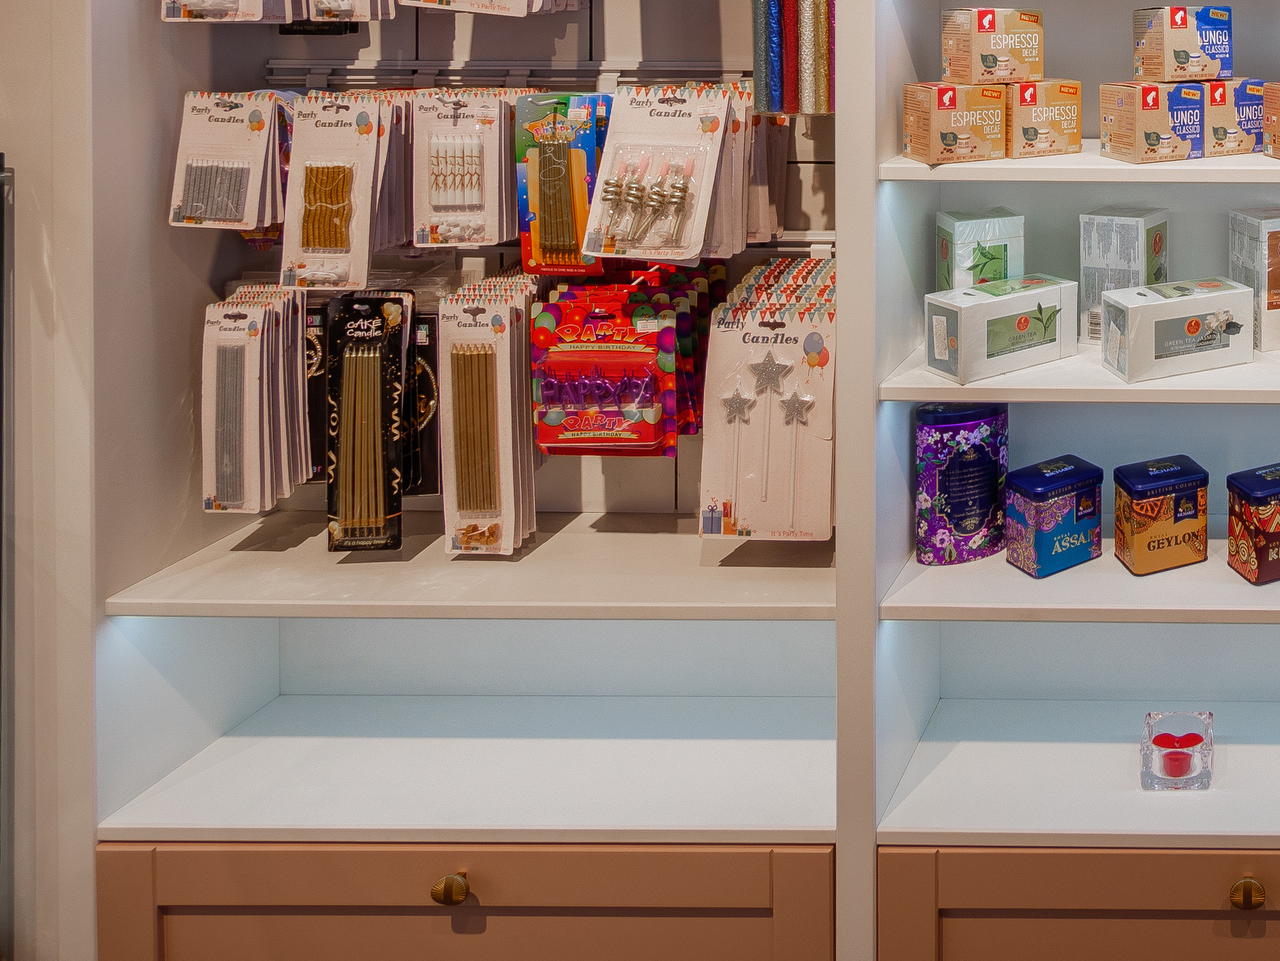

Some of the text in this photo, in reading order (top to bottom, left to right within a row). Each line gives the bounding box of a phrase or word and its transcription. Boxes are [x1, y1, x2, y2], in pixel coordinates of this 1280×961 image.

[1021, 14, 1038, 23] NEW!
[990, 34, 1039, 49] ESPRESSO
[1197, 30, 1229, 45] LUNGO
[1021, 48, 1039, 57] DECAF
[1205, 45, 1229, 53] CLASSICO
[983, 90, 1001, 98] NEW!
[1060, 87, 1077, 95] NEW!
[1183, 90, 1199, 99] NEW!
[1248, 86, 1263, 94] NEW!
[630, 98, 654, 108] Party
[191, 106, 213, 114] Party
[419, 105, 439, 113] Party
[649, 109, 692, 118] Candles
[1235, 106, 1263, 121] LUNGO
[297, 111, 318, 119] Party
[951, 110, 1001, 127] ESPRESSO
[1032, 106, 1077, 122] ESPRESSO
[1169, 109, 1200, 126] LUNGO
[208, 115, 245, 123] Candles
[315, 119, 353, 128] Candles
[1061, 121, 1077, 129] DECAF
[1176, 125, 1200, 134] CLASSICO
[983, 126, 1001, 134] DECAF
[441, 313, 459, 321] Party
[716, 318, 746, 331] Party
[347, 329, 382, 337] Candle
[555, 322, 652, 342] PARTY
[742, 333, 799, 345] Candles
[562, 414, 635, 430] PARTY
[1045, 465, 1074, 477] RICHARD
[1149, 466, 1181, 476] RICHARD
[1147, 481, 1200, 496] BRITISH COLONY
